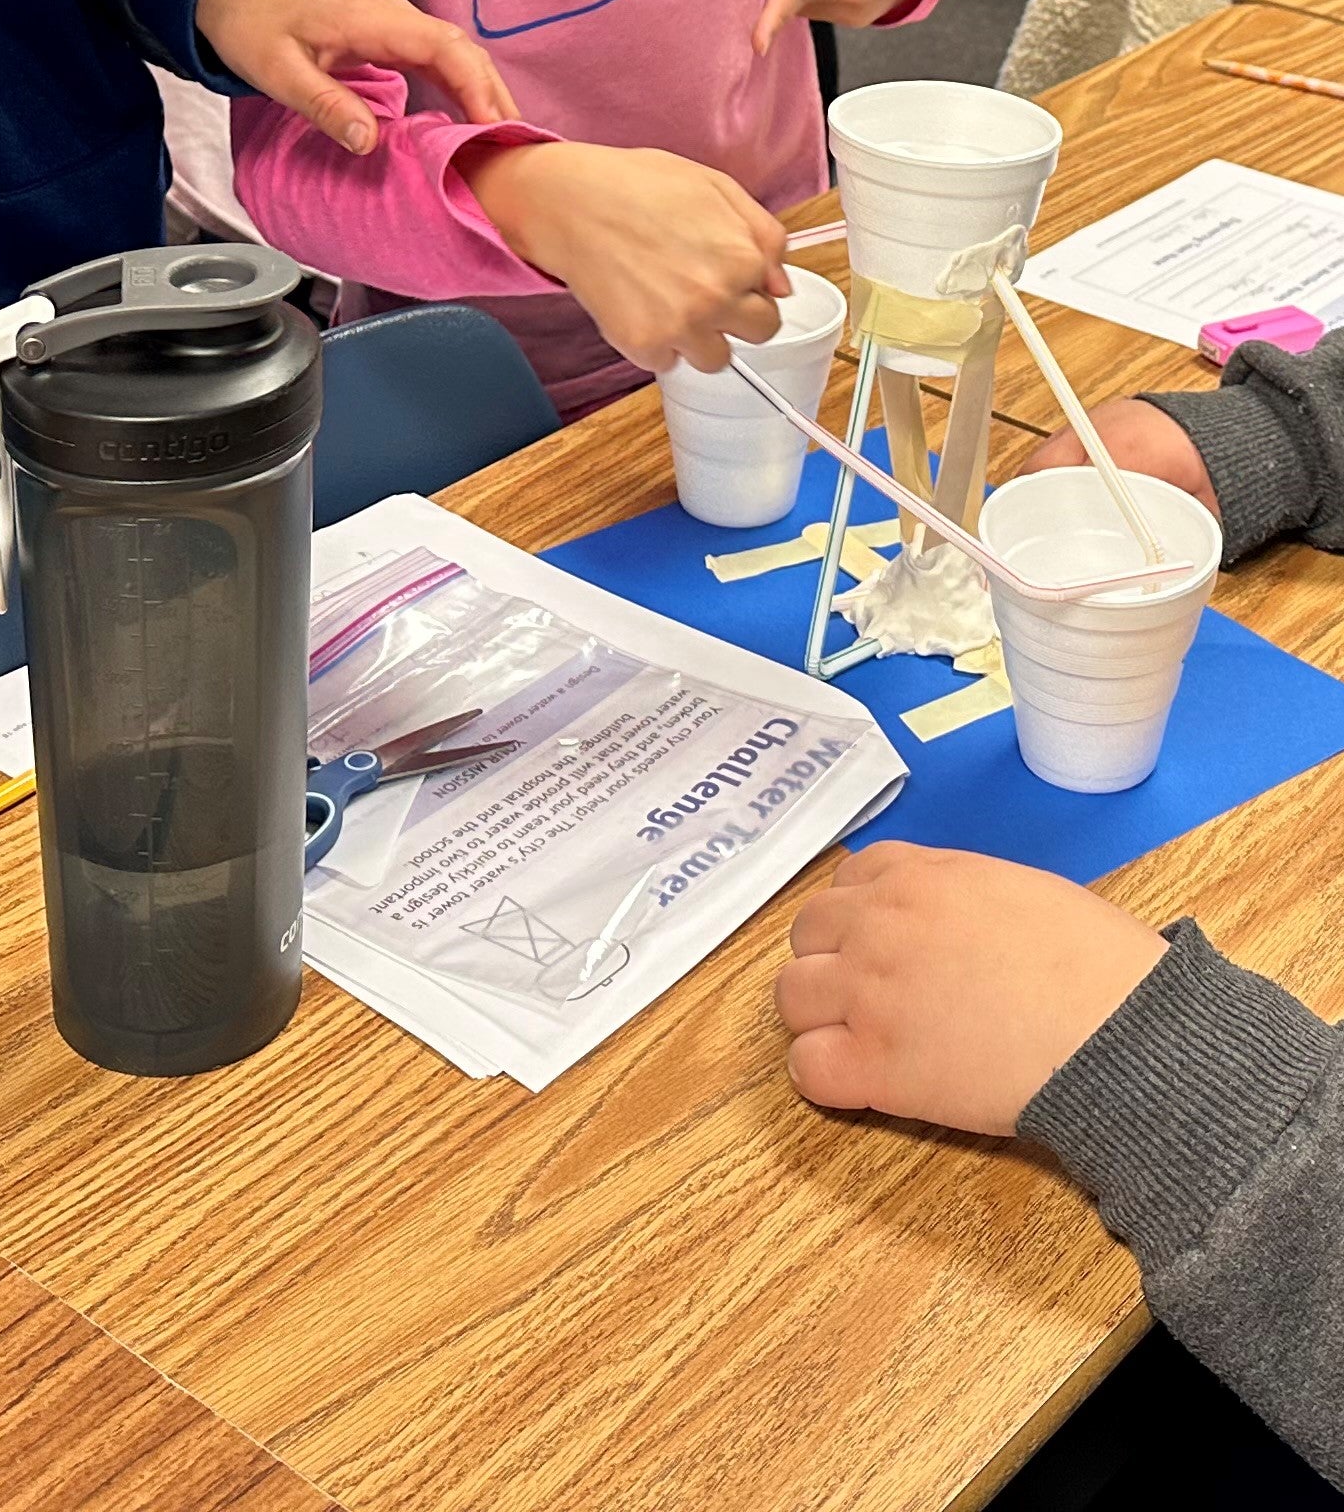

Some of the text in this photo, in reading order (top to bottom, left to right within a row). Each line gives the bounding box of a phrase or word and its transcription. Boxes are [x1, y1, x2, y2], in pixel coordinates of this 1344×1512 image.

[481, 665, 602, 743] Design a water tower to
[368, 688, 692, 915] water tower that will provide water to two important
[431, 760, 489, 800] MISSION
[504, 769, 557, 806] hospital
[551, 754, 577, 771] the
[636, 717, 800, 842] Challenge
[390, 696, 708, 922] broken, and they need your team to quickly design a
[411, 705, 724, 931] Your city needs your help! The city's water tower is
[452, 820, 479, 838] the
[476, 802, 504, 823] and
[649, 737, 857, 908] Water Tower
